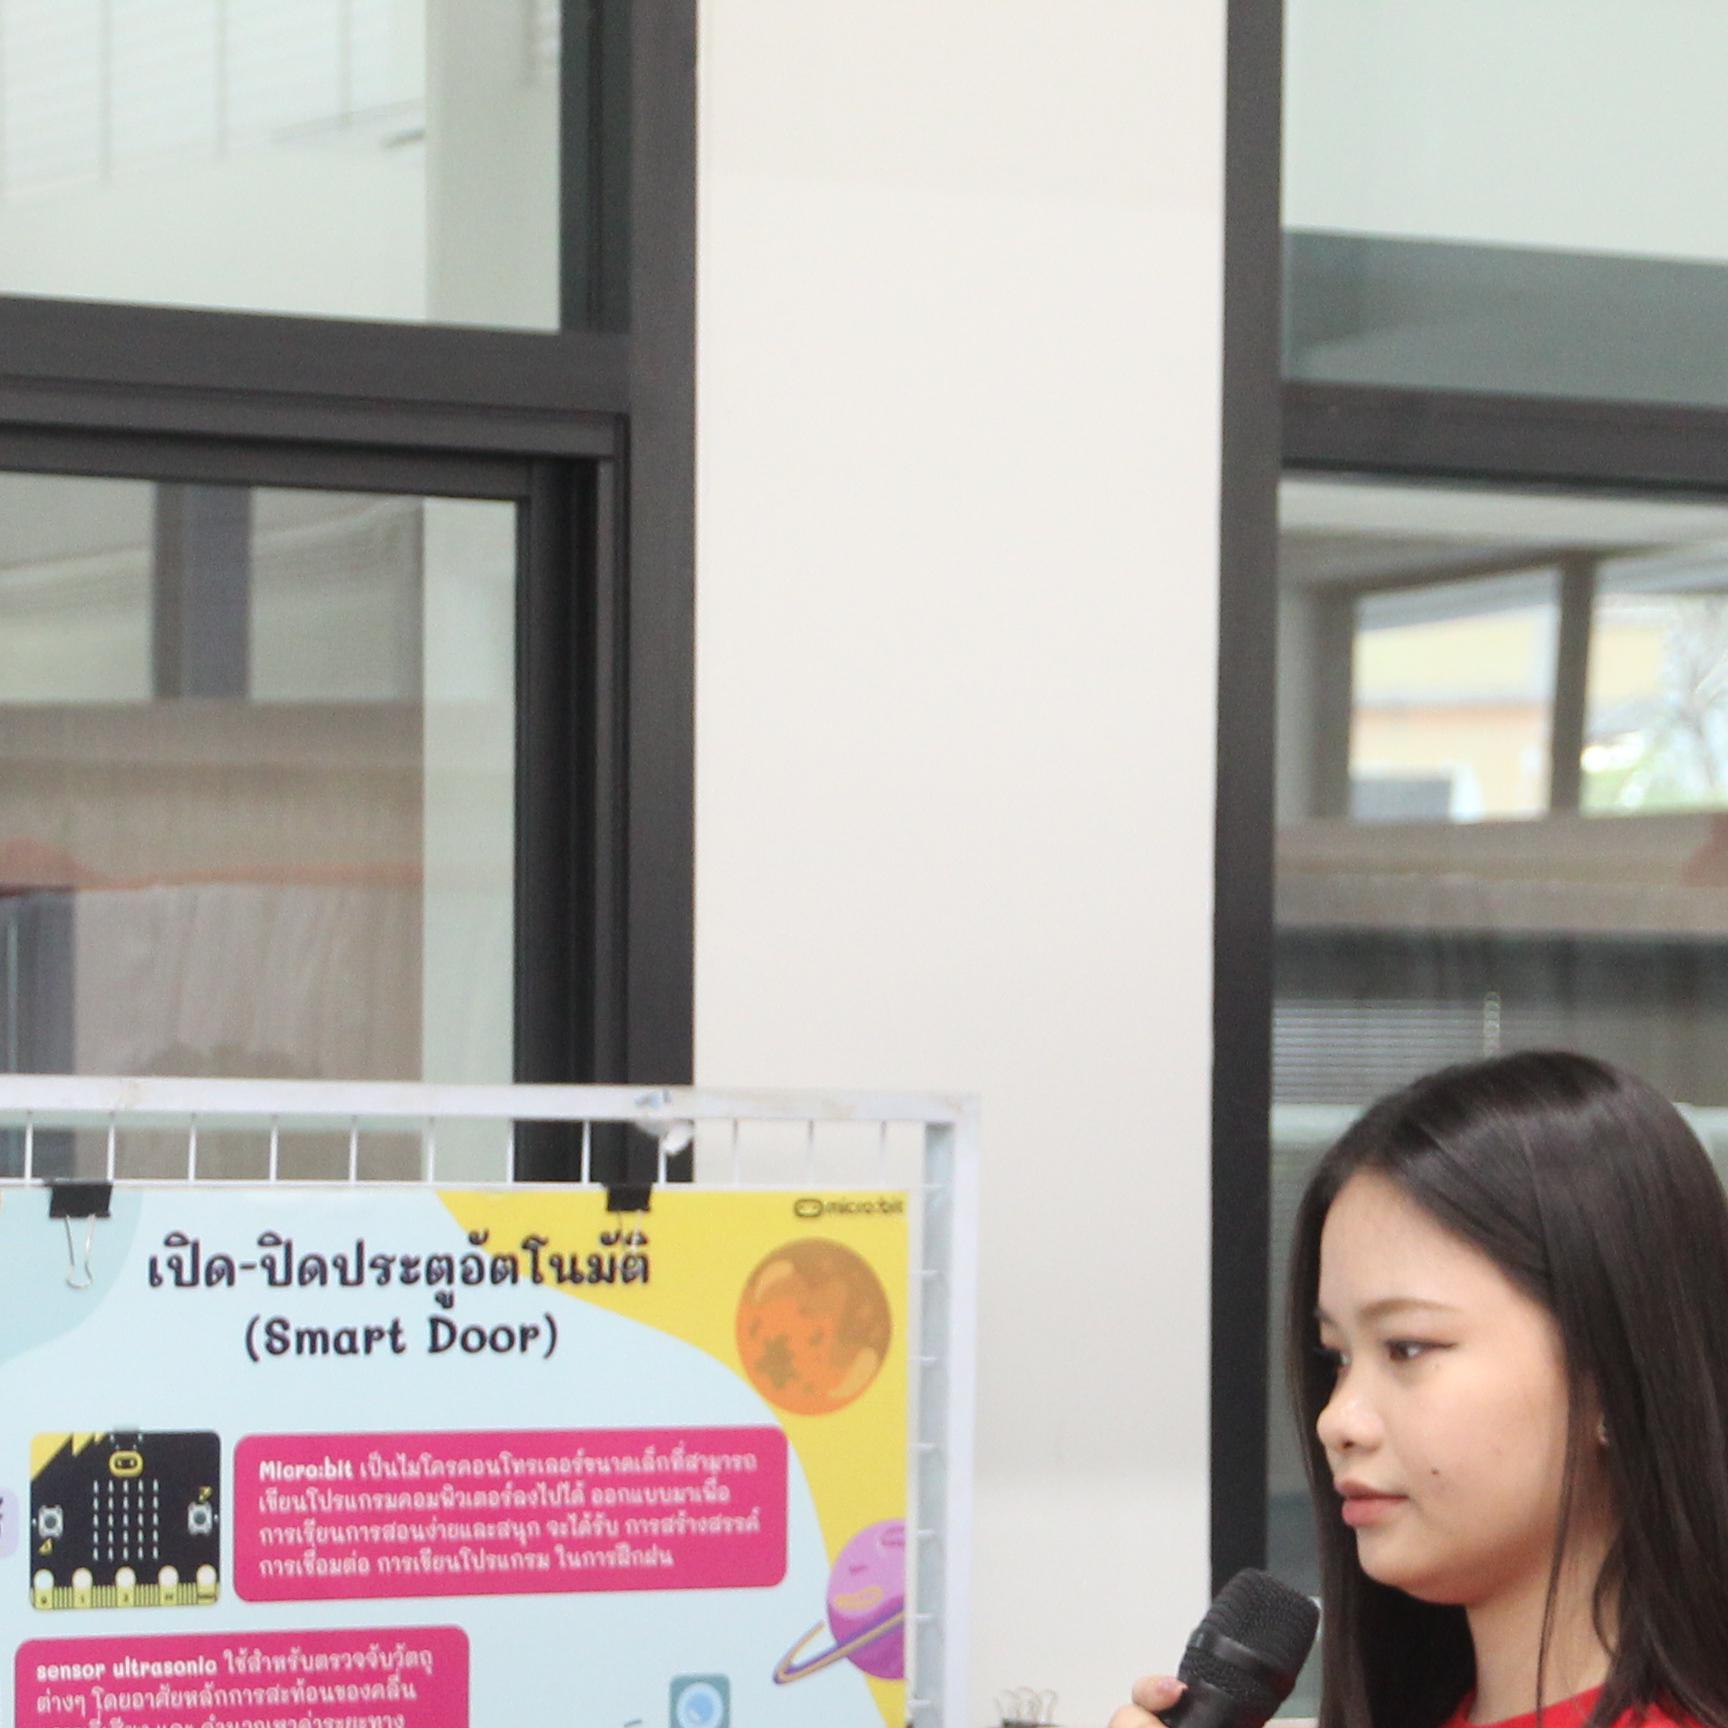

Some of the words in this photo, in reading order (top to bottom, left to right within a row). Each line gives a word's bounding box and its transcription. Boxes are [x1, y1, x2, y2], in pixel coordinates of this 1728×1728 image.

[148, 1229, 650, 1308] เปิด-ปิดประตูอัตโนมัติ
[245, 1313, 407, 1361] (Smart
[428, 1313, 559, 1359] Door)
[258, 1456, 354, 1481] Micro:bit
[36, 1661, 107, 1682] sensor
[113, 1655, 218, 1679] ultrasonic
